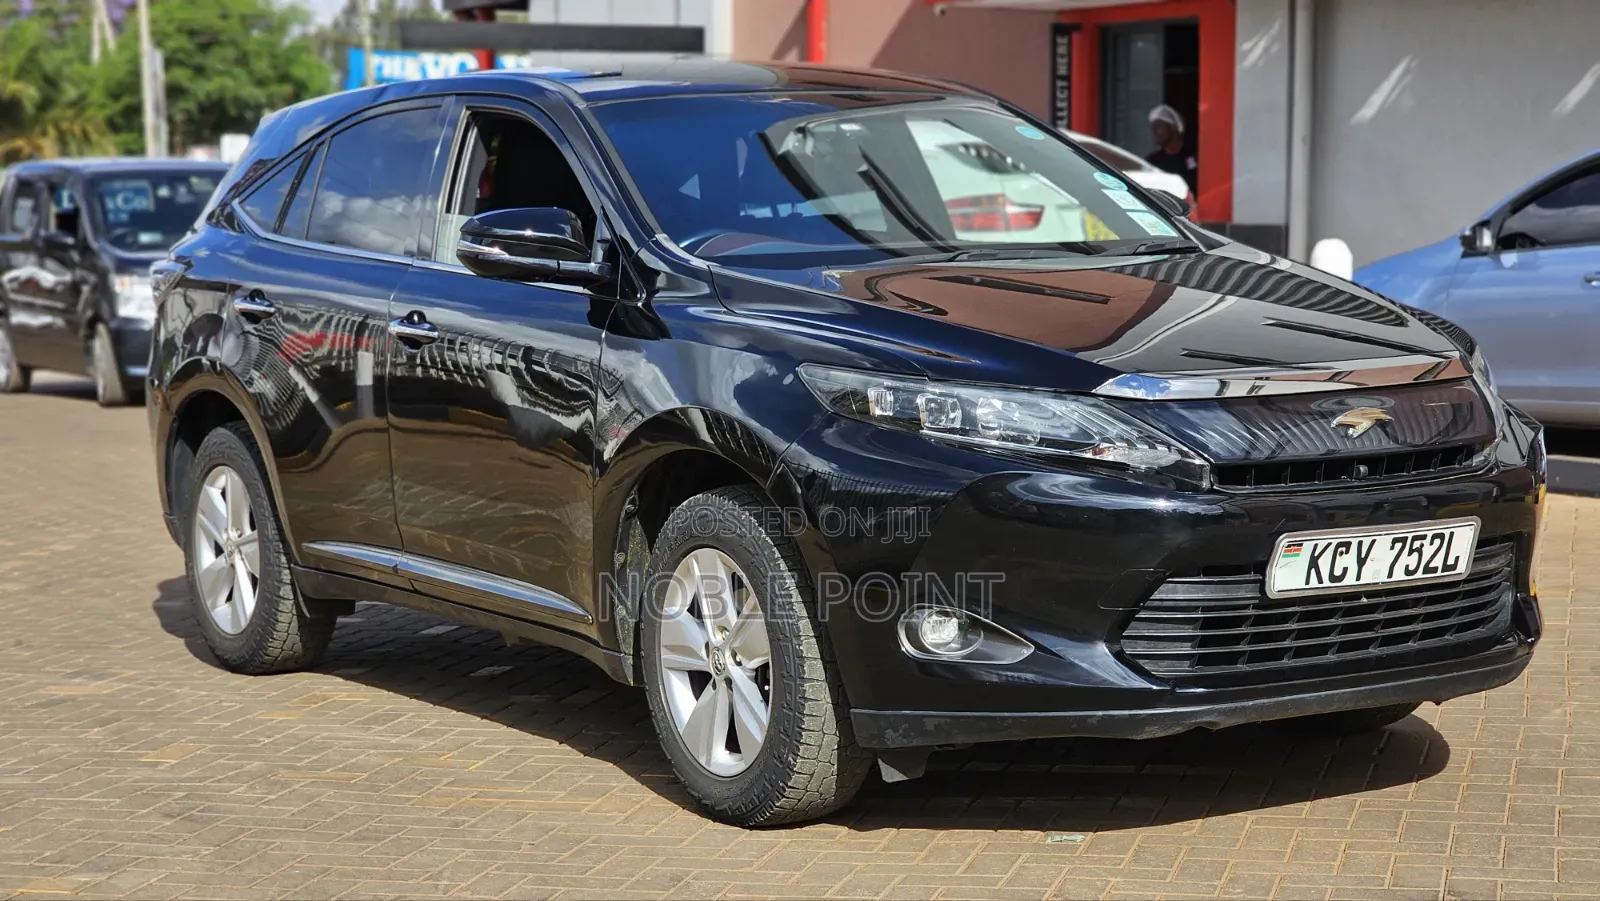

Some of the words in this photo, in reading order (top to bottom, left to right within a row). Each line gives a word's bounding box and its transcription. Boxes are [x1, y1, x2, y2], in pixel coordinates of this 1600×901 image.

[1056, 35, 1068, 76] HERE
[1056, 79, 1069, 127] LLECT
[1305, 539, 1376, 586] KCY
[1387, 531, 1461, 579] 752L
